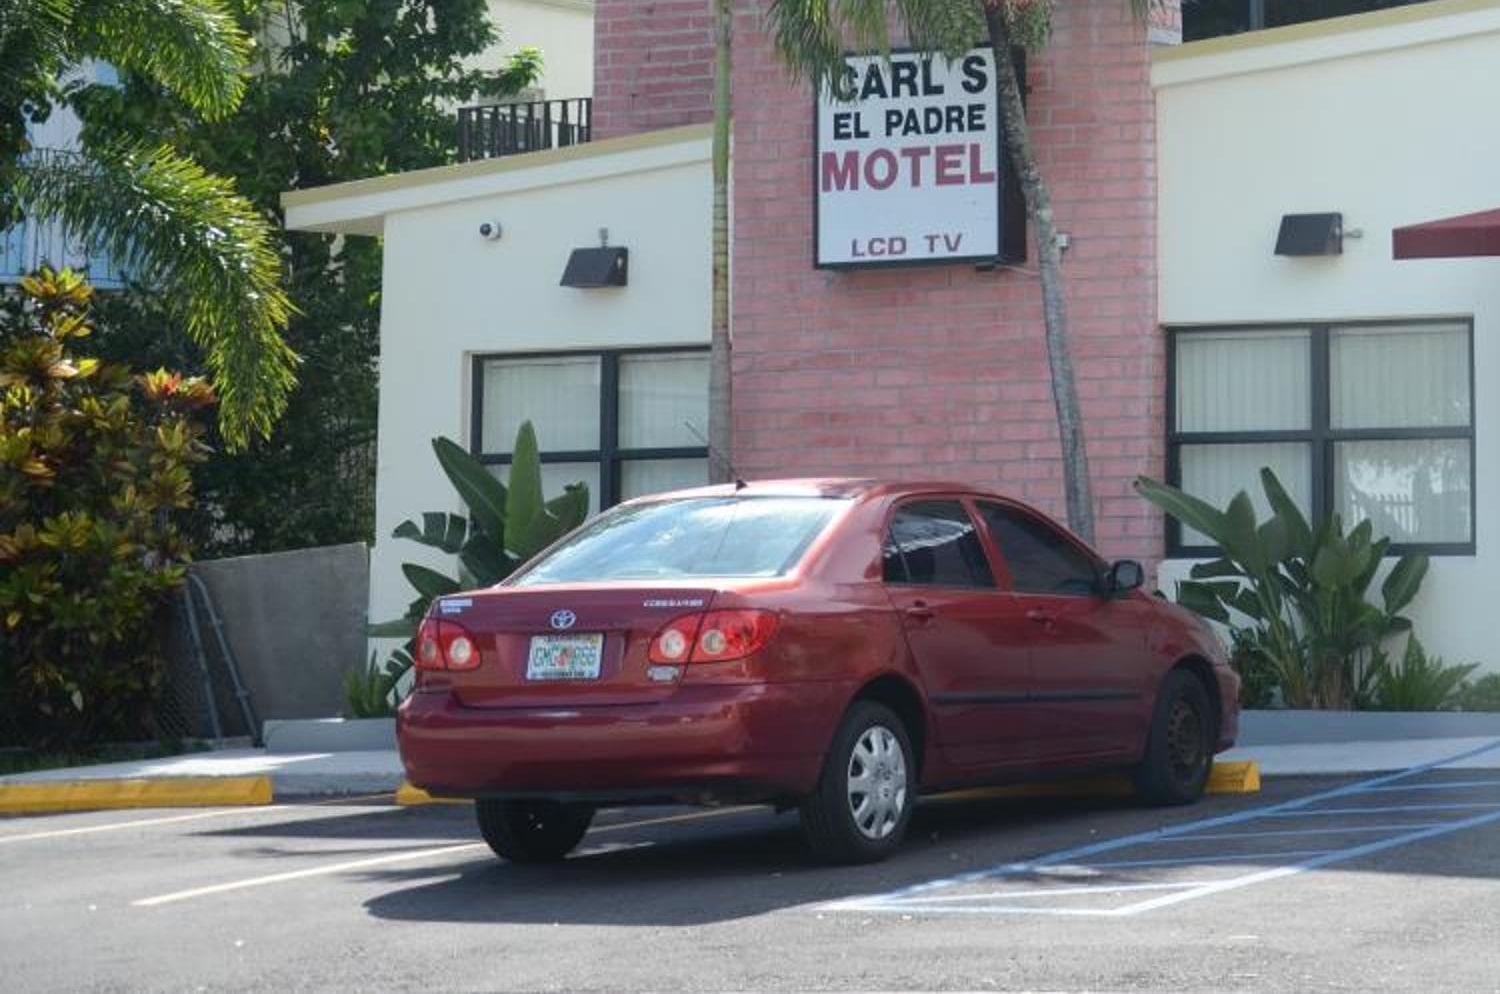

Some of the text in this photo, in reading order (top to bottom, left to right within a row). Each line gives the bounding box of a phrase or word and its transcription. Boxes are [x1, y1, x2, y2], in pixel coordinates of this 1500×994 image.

[833, 104, 986, 140] EL PADRE
[821, 143, 995, 192] MOTEL
[851, 233, 963, 257] LCD TV
